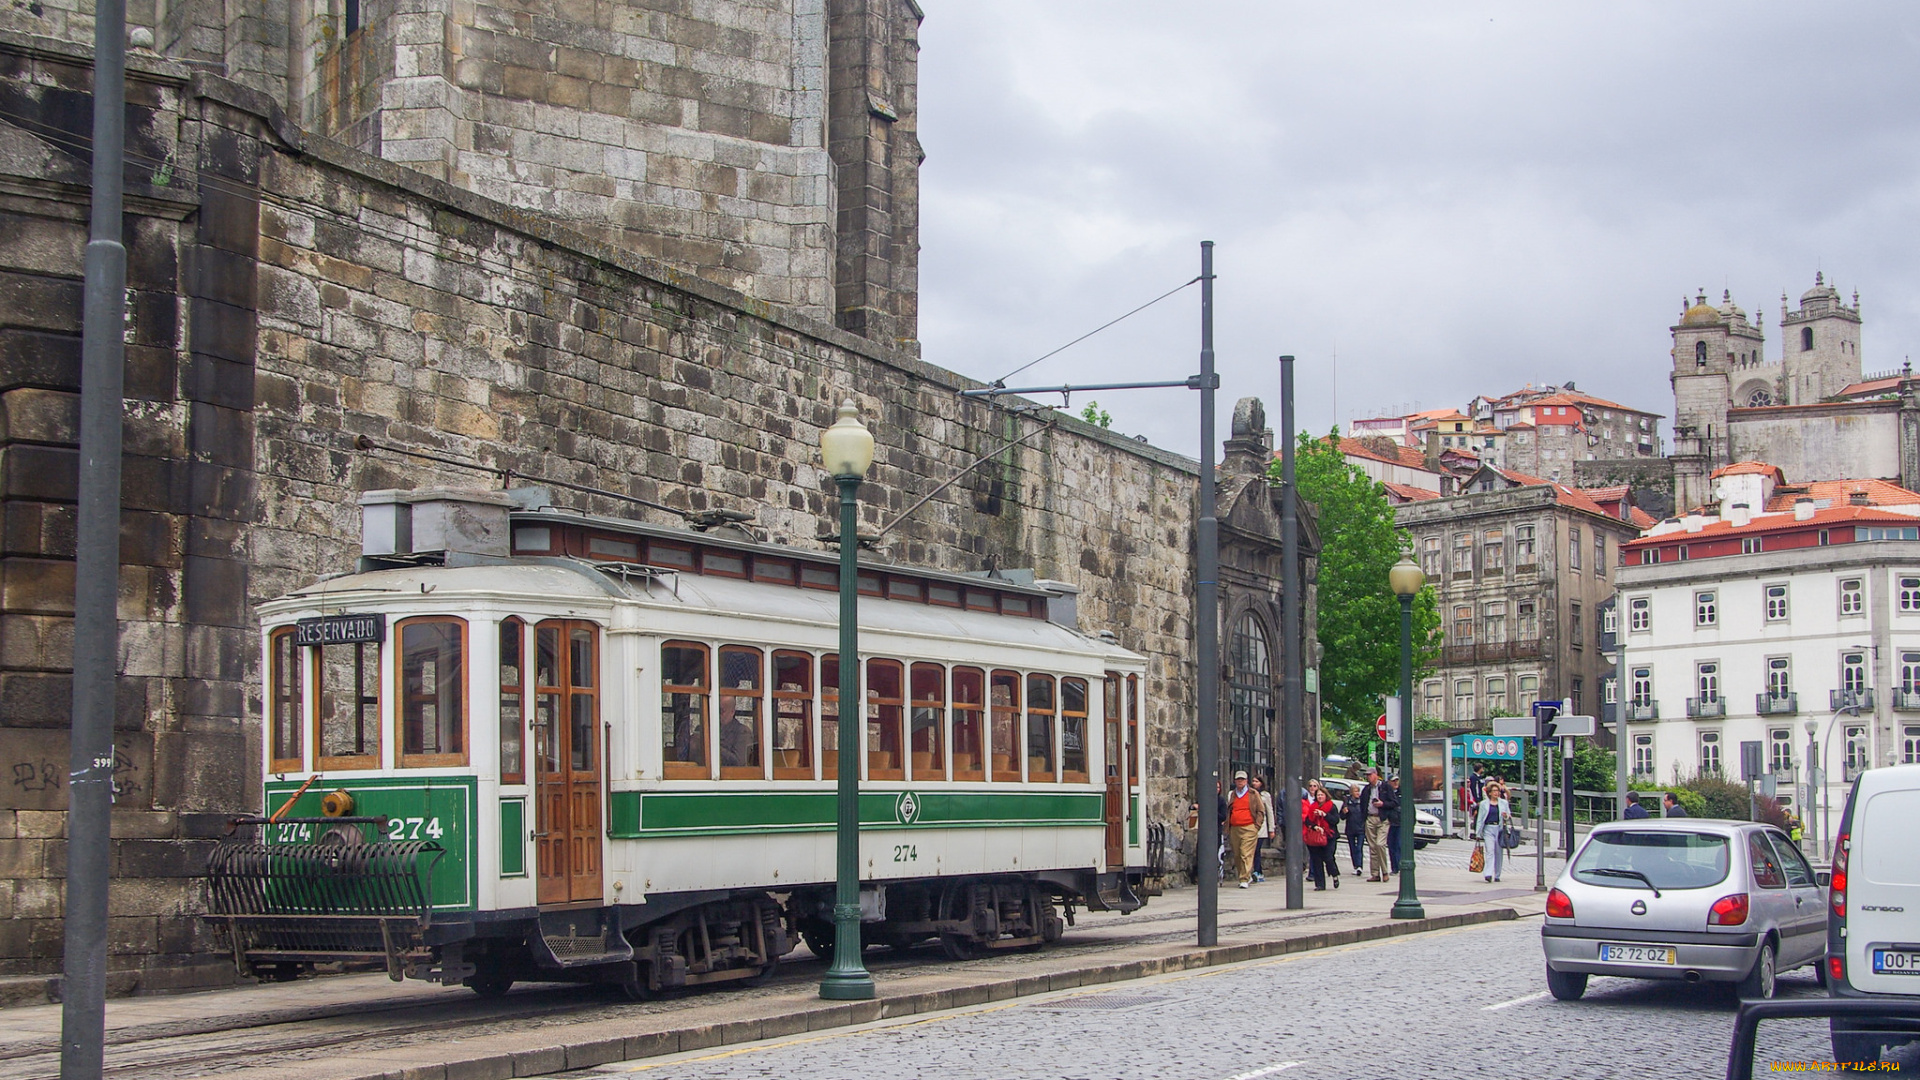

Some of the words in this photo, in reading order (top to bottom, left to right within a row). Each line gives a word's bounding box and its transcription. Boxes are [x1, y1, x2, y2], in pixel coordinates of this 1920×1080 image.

[298, 620, 374, 642] RESERVADO
[278, 823, 310, 842] 274
[387, 817, 443, 840] 274
[893, 844, 917, 862] 274
